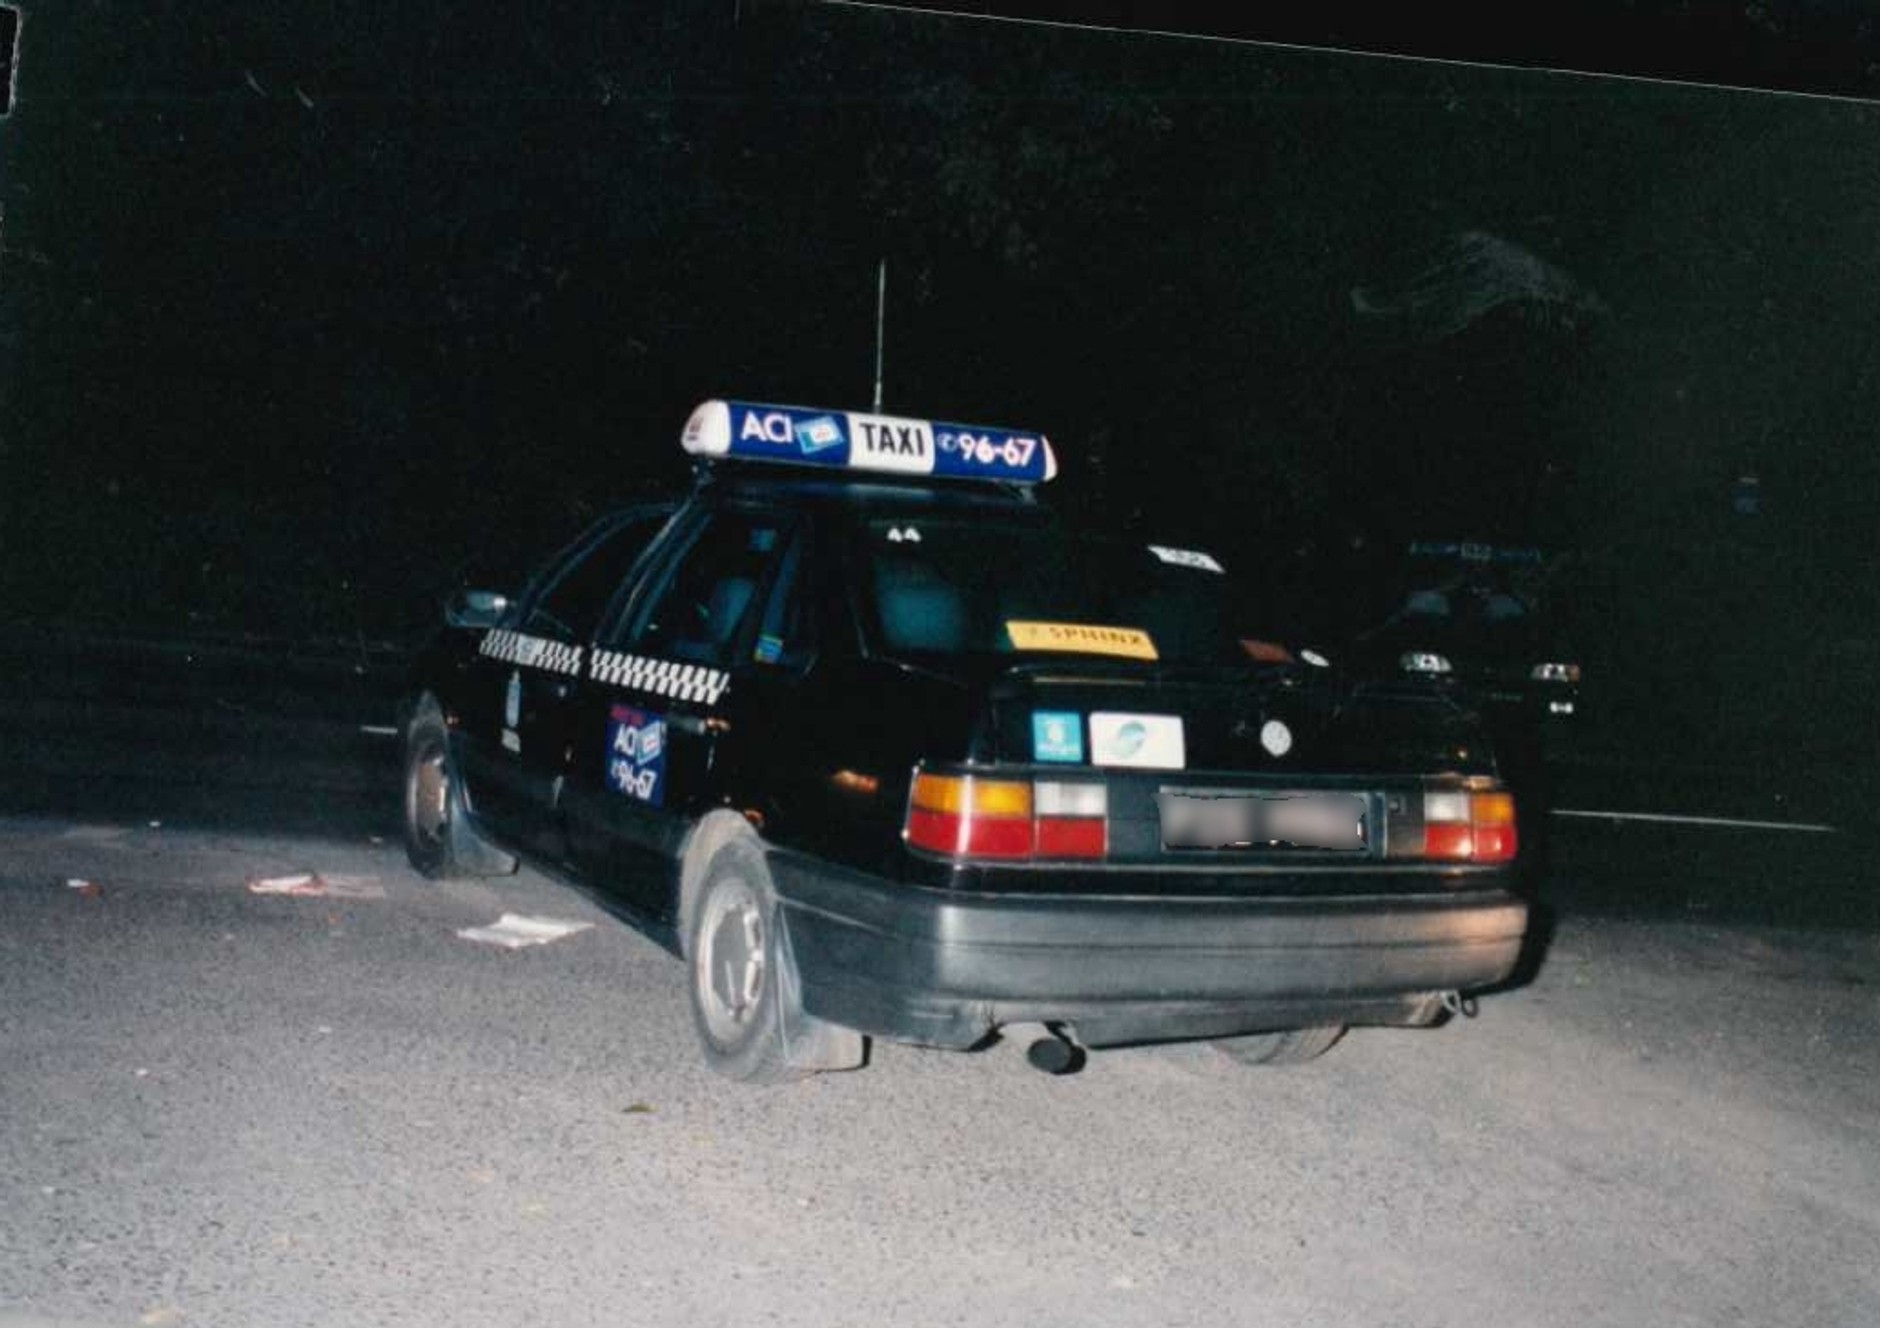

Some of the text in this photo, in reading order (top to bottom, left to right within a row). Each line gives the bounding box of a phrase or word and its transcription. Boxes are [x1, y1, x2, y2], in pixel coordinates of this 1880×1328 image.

[741, 411, 1036, 466] ACI TAXI 96-67
[1050, 627, 1141, 644] SPHINX
[620, 761, 657, 800] 96-67
